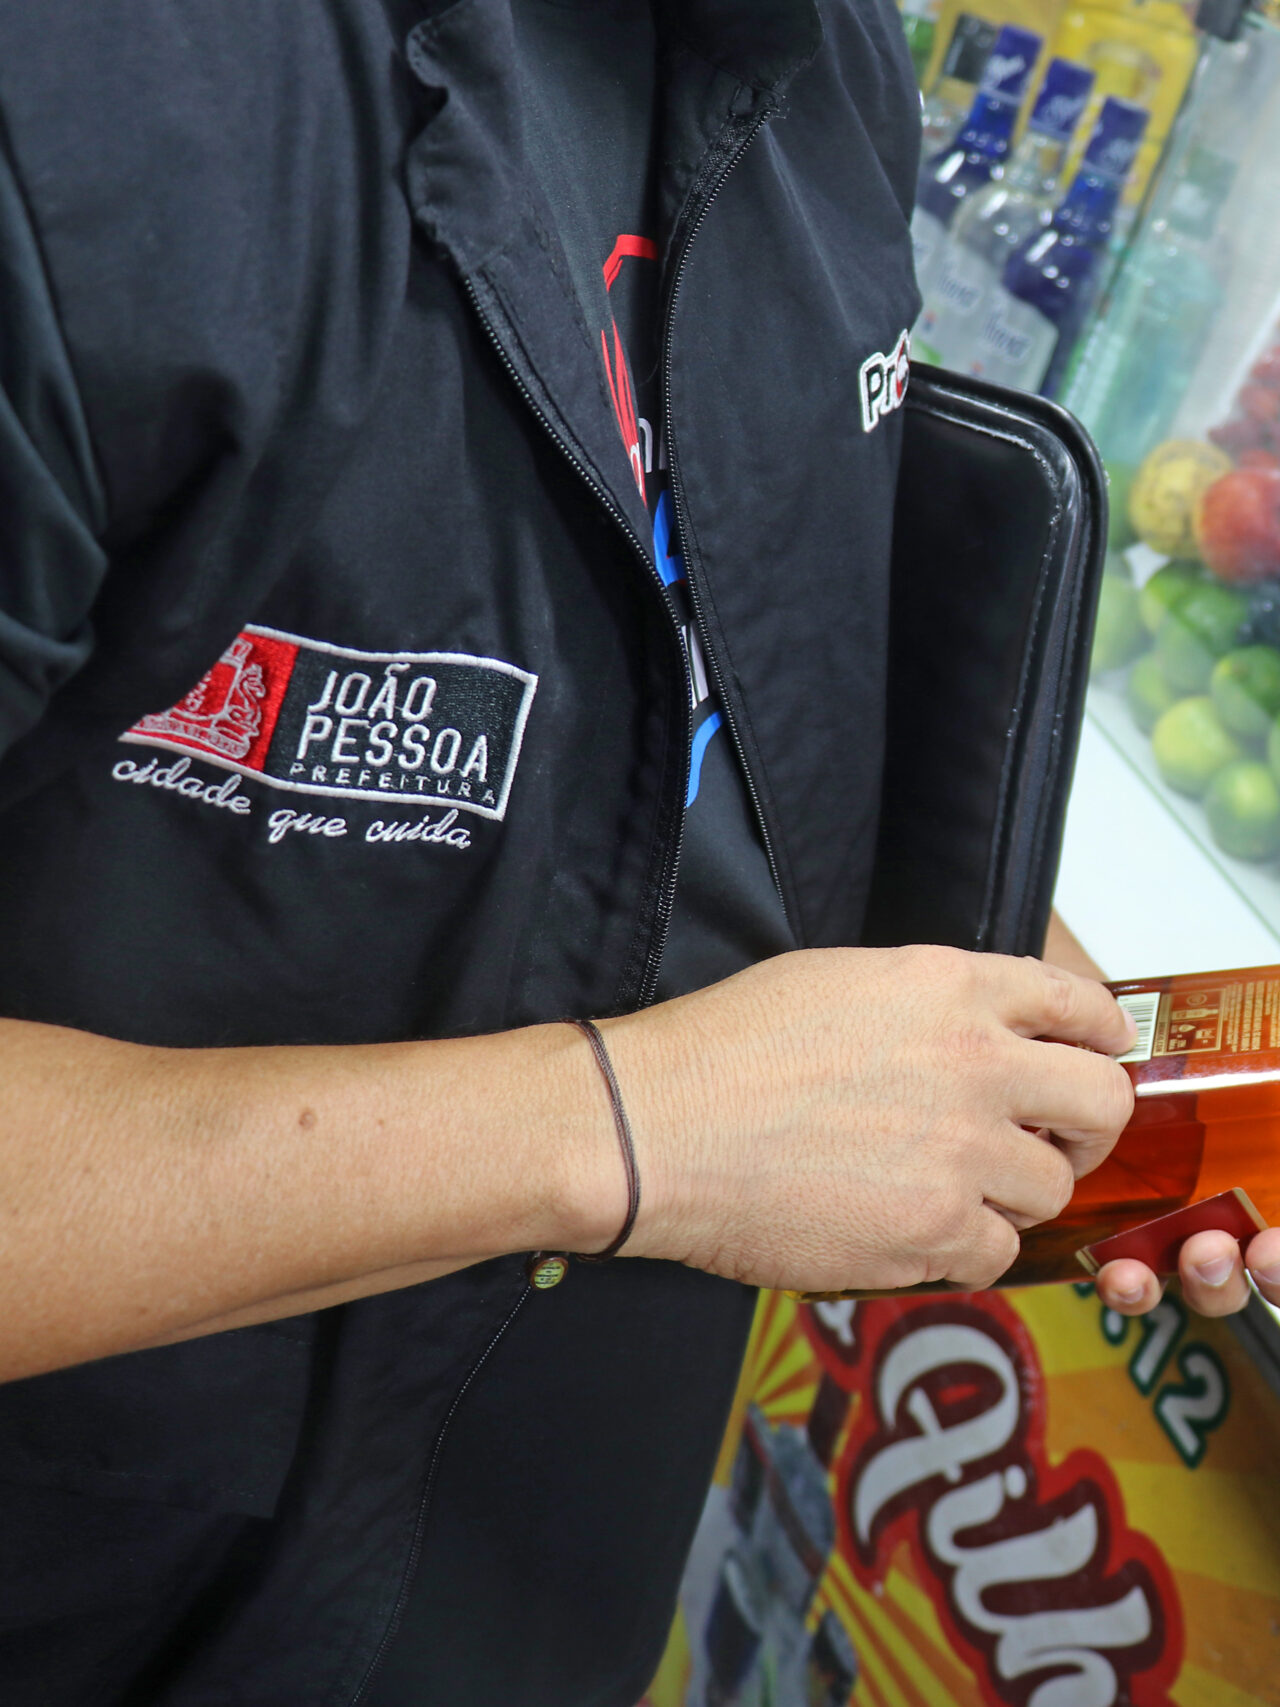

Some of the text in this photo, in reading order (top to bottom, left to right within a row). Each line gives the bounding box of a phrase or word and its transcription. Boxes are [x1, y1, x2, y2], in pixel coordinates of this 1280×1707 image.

[306, 662, 437, 723] JOÃO
[295, 713, 488, 783] PESSOA
[110, 757, 471, 850] cidade que cuida
[288, 761, 497, 805] PREFEITURA
